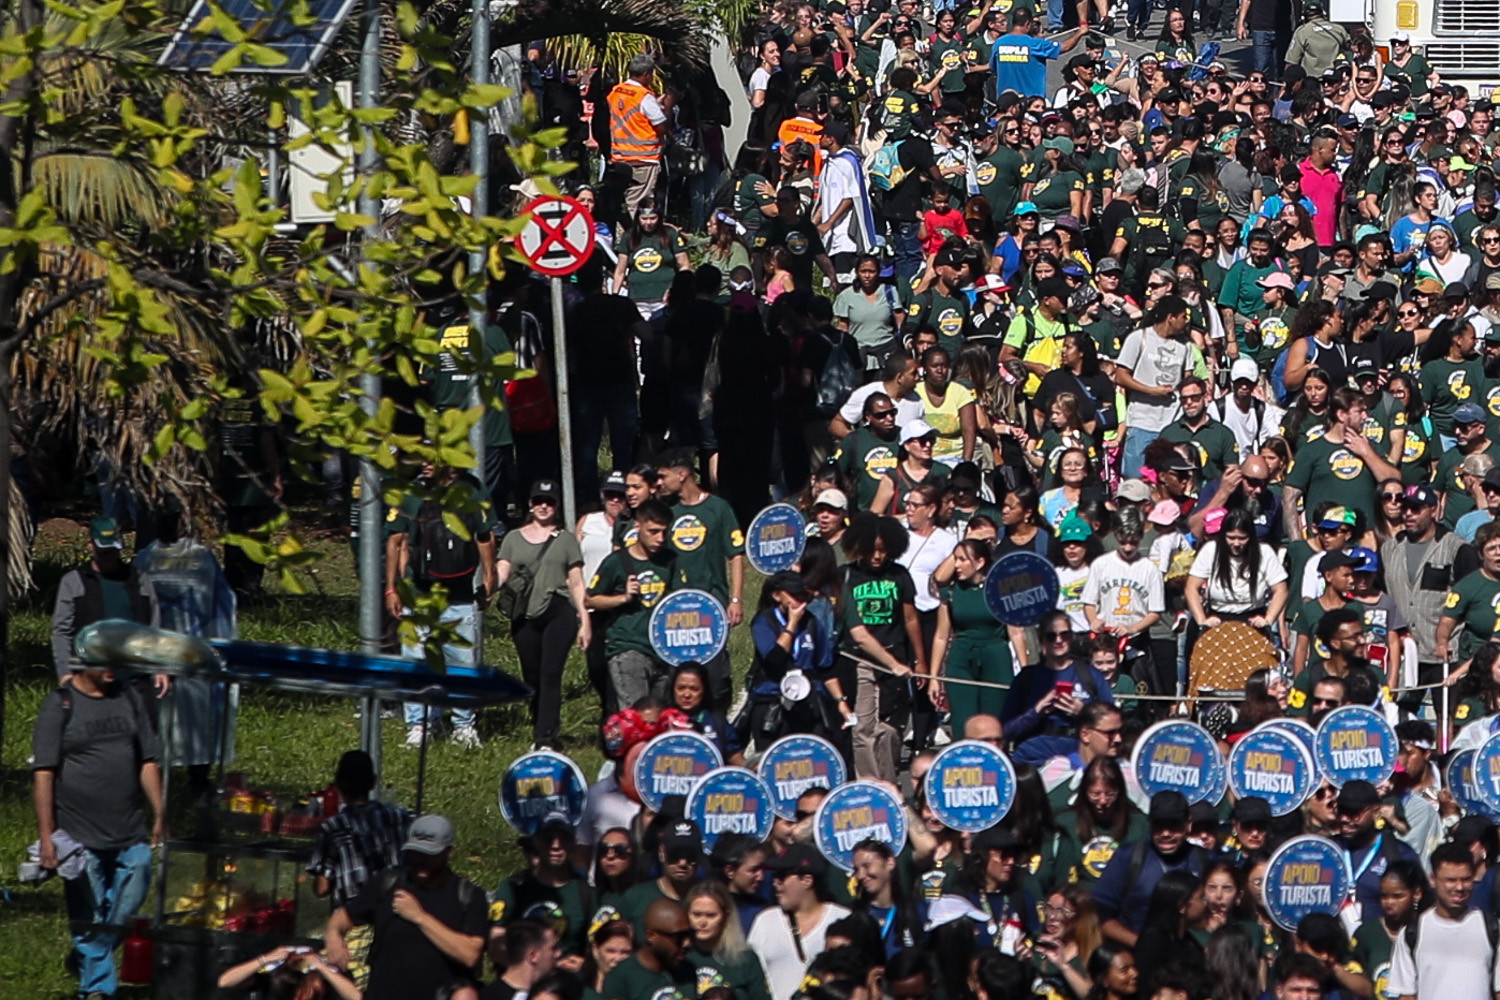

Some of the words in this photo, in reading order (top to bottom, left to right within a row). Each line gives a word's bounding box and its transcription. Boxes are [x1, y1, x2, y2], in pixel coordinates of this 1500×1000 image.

[760, 523, 785, 540] APOIO
[758, 538, 795, 556] TURISTA
[1100, 577, 1149, 600] GARFIELD
[666, 612, 700, 627] APOIO
[665, 629, 713, 647] TURISTA
[1332, 729, 1367, 749] APOIO
[1154, 743, 1192, 763] APOIO
[1246, 752, 1281, 771] APOIO
[1331, 748, 1384, 769] TURISTA
[655, 755, 694, 773] APOIO
[775, 759, 813, 780] APOIO
[1149, 762, 1199, 787] TURISTA
[652, 774, 697, 795] TURIST
[943, 767, 983, 787] APOIO
[1244, 770, 1295, 794] TURISTA
[705, 793, 744, 814] APOIO
[942, 786, 999, 808] TURISTA
[703, 814, 757, 835] TURISTA
[833, 806, 873, 830] APOIO
[1282, 863, 1321, 884] APOIO
[1280, 884, 1331, 906] TURISTA
